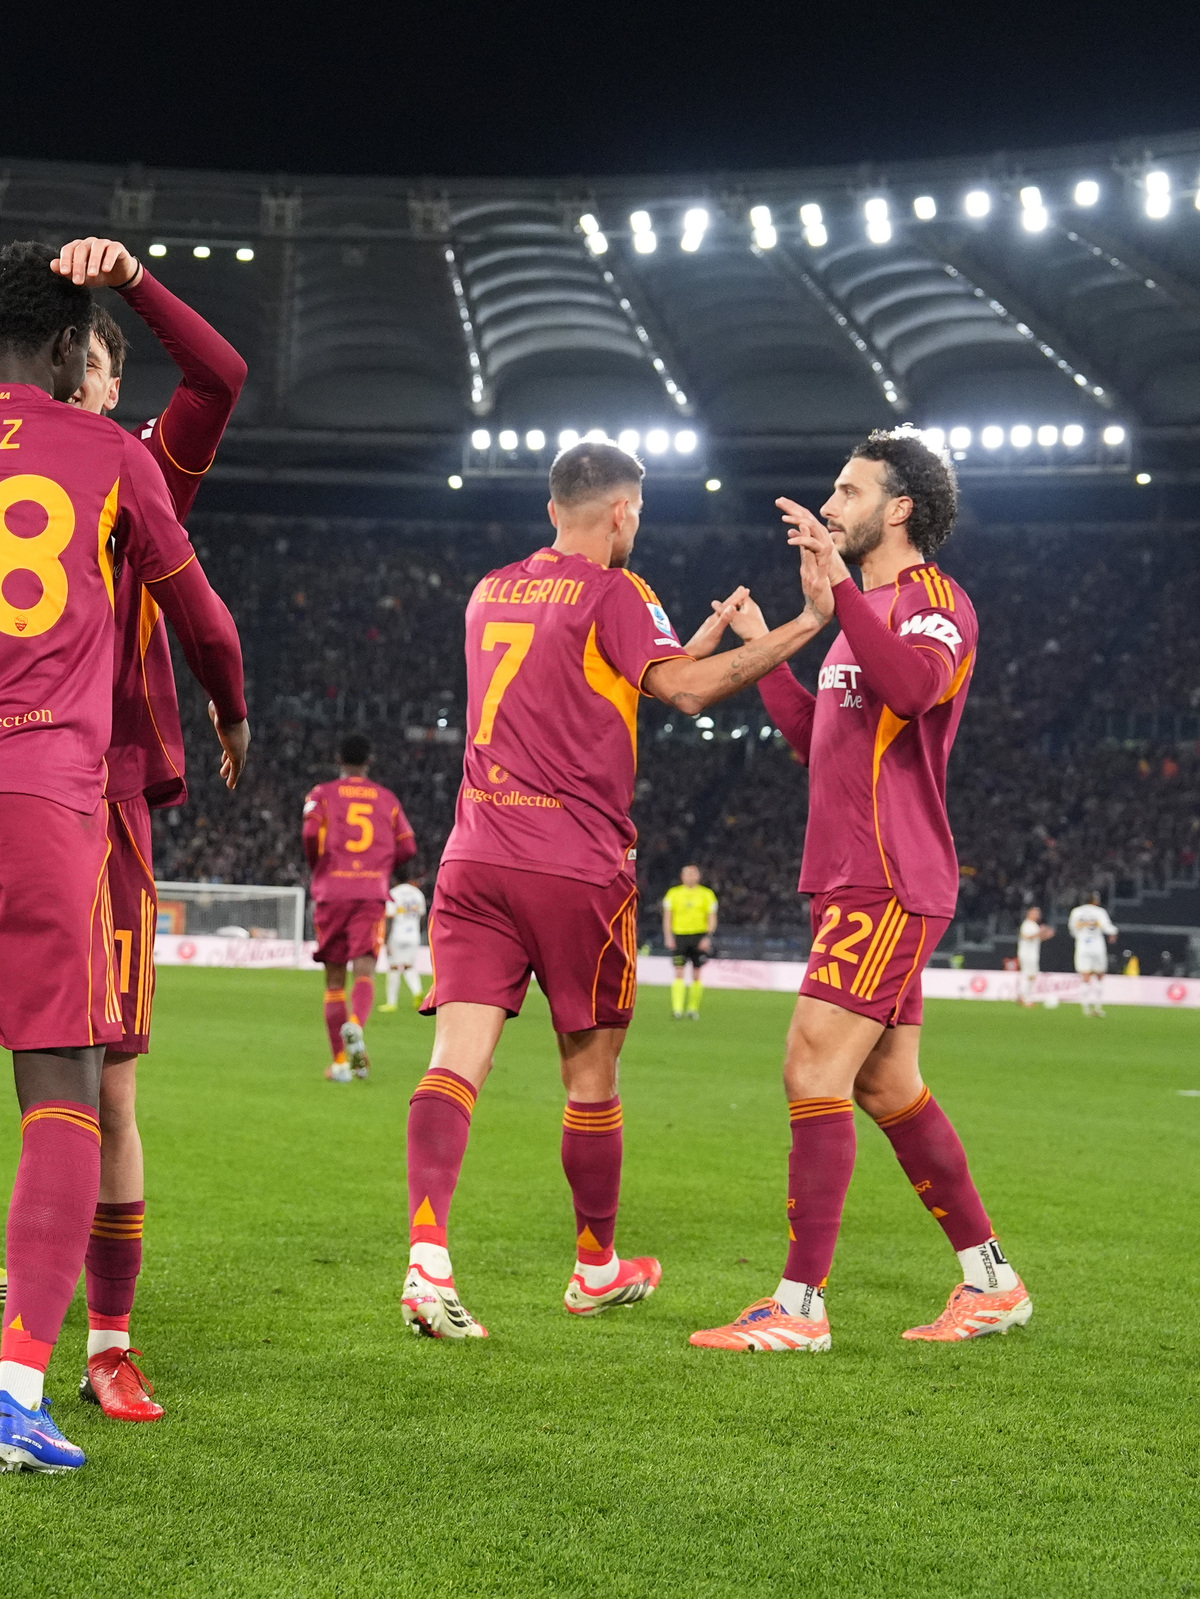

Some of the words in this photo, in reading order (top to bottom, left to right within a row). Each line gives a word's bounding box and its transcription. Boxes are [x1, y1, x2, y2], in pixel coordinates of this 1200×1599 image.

[474, 621, 535, 744] 7
[344, 802, 374, 853] 5
[811, 905, 873, 964] 22
